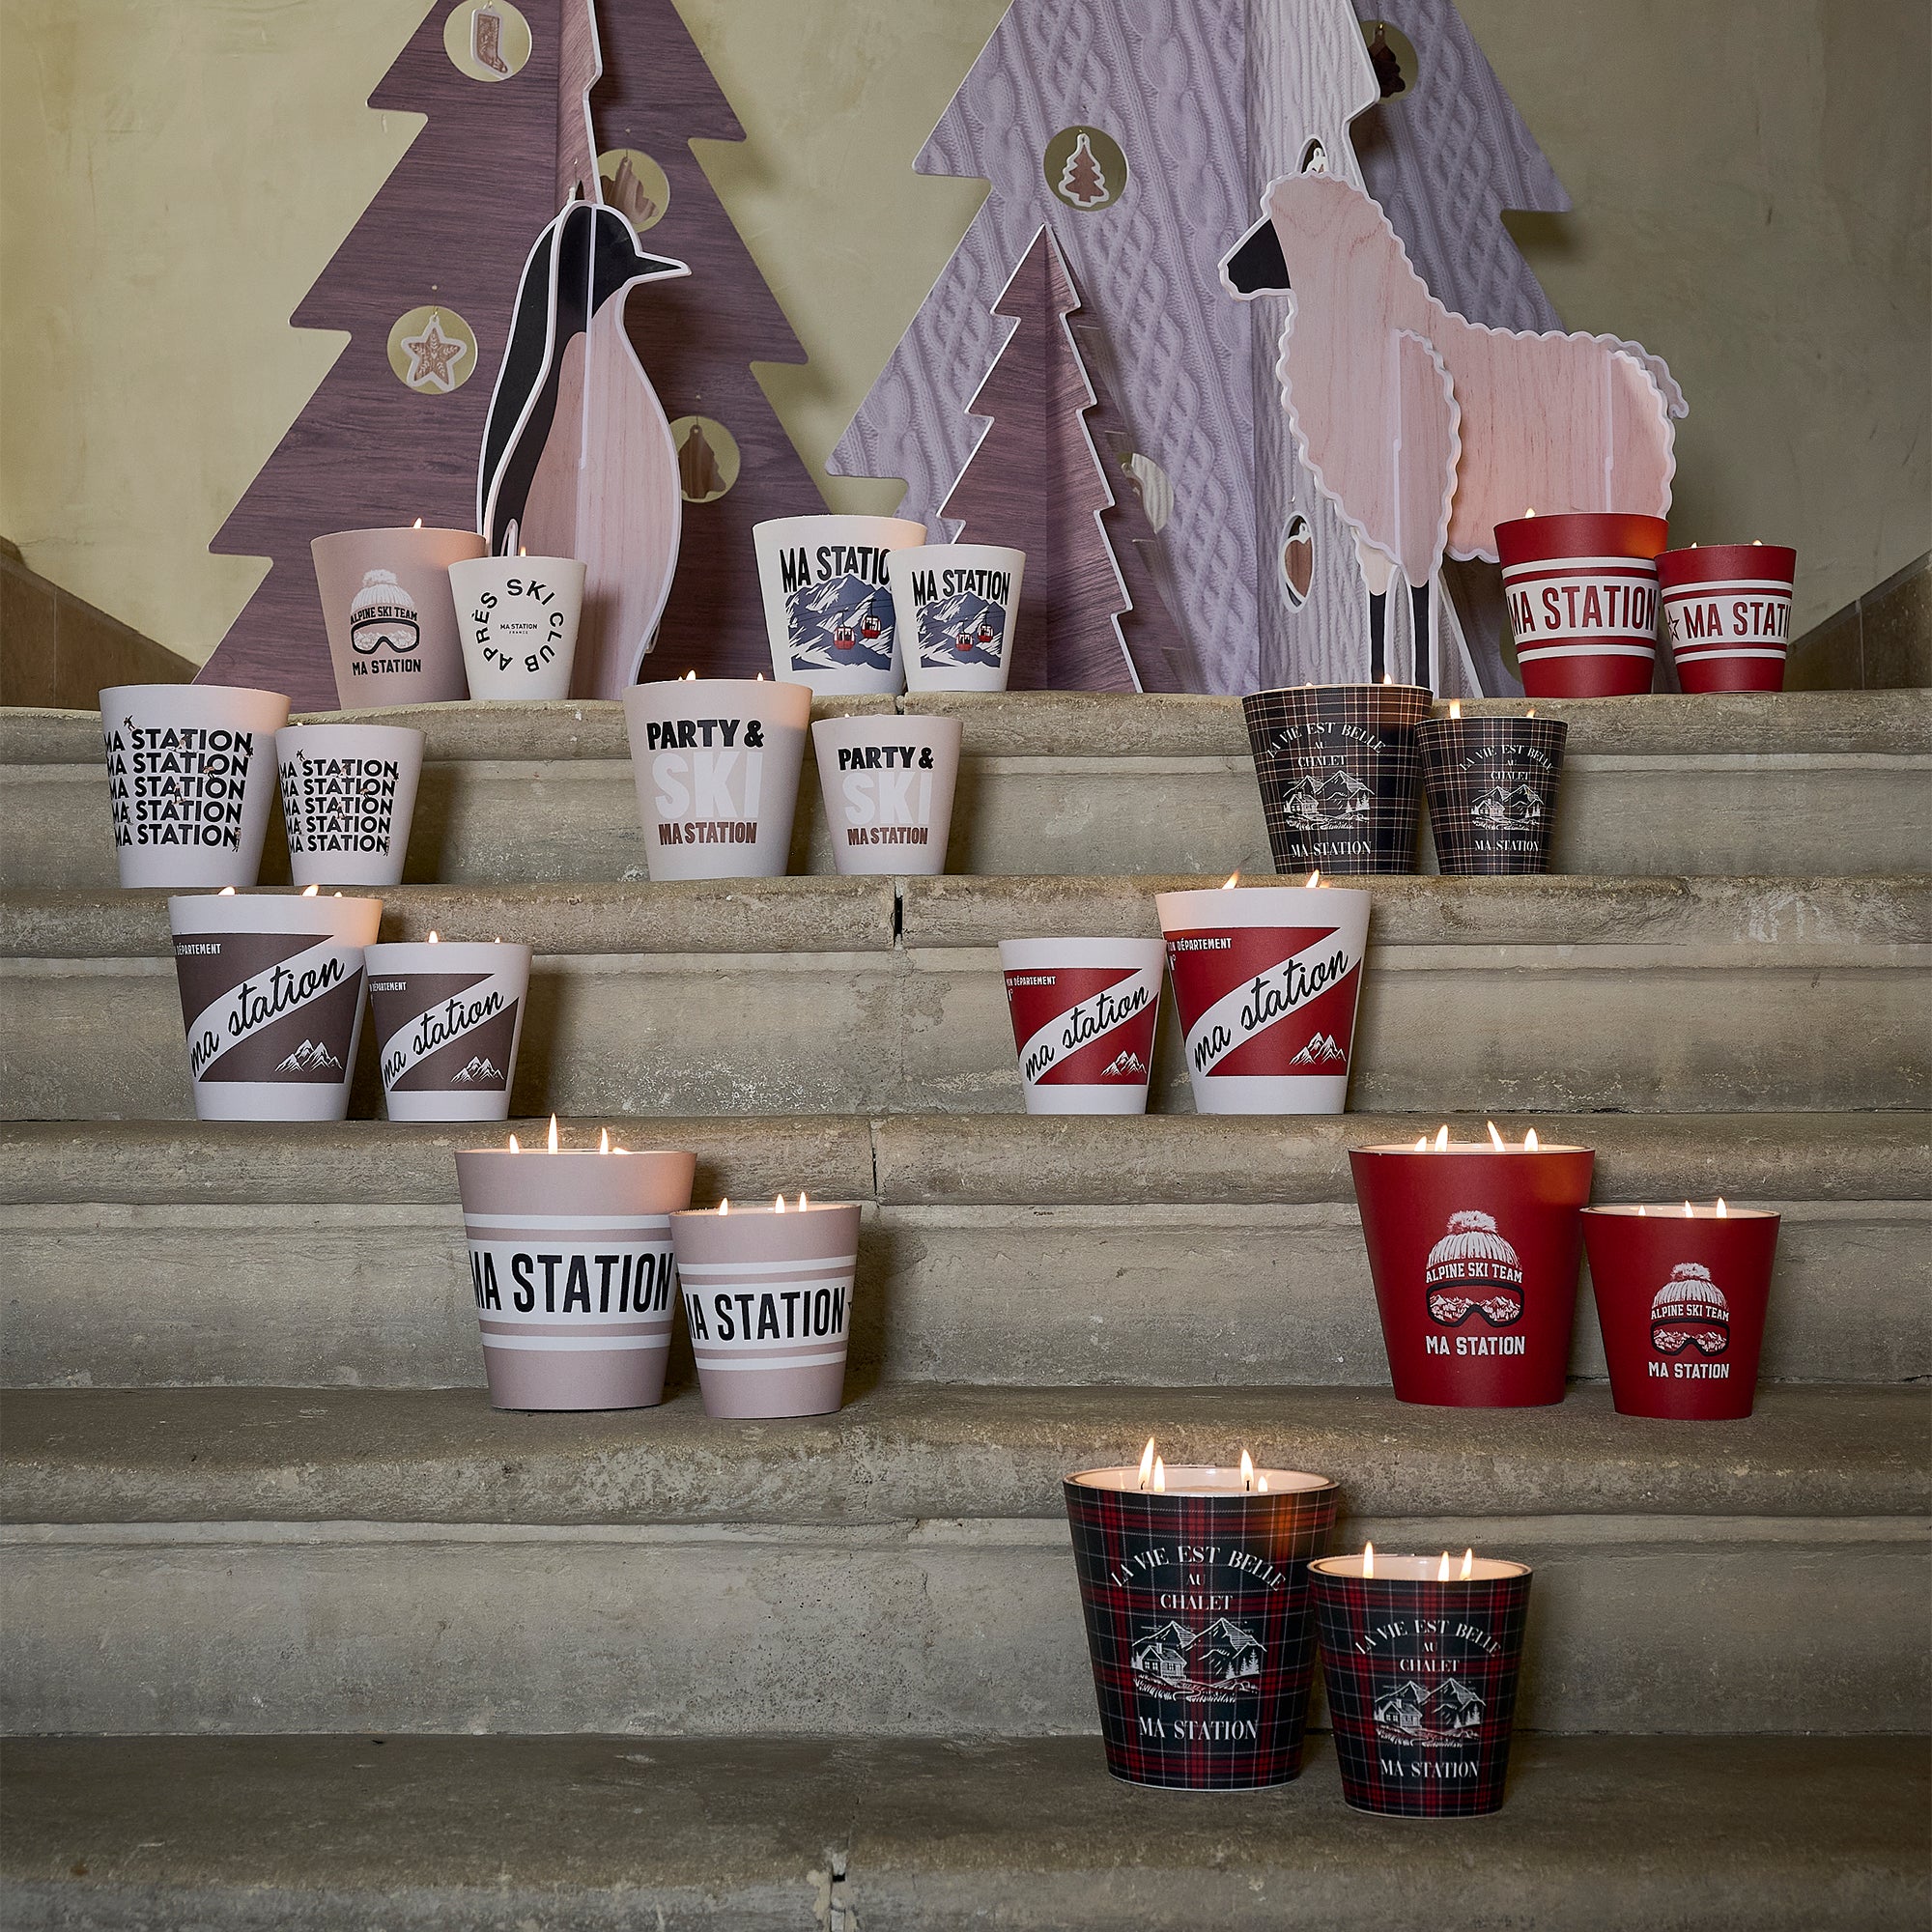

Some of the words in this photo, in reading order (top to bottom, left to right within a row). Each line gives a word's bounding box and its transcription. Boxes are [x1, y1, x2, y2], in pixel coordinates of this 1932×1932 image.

[780, 548, 811, 593] MA
[816, 546, 892, 585] STATIO
[507, 579, 555, 606] SKI
[912, 570, 938, 606] MA
[942, 569, 1010, 605] STATION
[351, 607, 376, 624] ALPINE
[378, 606, 392, 617] SKI
[394, 607, 417, 621] TEAM
[1507, 591, 1536, 636] MA
[1542, 585, 1657, 631] STATION
[1683, 603, 1722, 639] MA
[1732, 602, 1791, 639] STATI
[471, 592, 513, 671] APRÈS
[525, 612, 563, 672] CLUB
[352, 662, 368, 675] MA
[372, 659, 421, 673] STATION
[103, 730, 126, 753] MA
[131, 728, 252, 753] STATION
[646, 720, 740, 750] PARTY
[744, 720, 765, 748] &
[1267, 742, 1281, 758] LA
[1279, 726, 1302, 744] VIE
[1306, 722, 1336, 735] EST
[1341, 724, 1386, 754] BELLE
[106, 754, 128, 777] MA
[133, 753, 249, 777] STATION
[302, 758, 398, 778] STATION
[838, 747, 916, 771] PARTY
[919, 747, 933, 769] &
[1297, 755, 1348, 768] CHALET
[1459, 757, 1475, 771] LA
[1475, 746, 1497, 759] VIE
[1502, 744, 1524, 754] EST
[1527, 748, 1553, 773] BELLE
[303, 778, 395, 797] STATION
[652, 751, 763, 819] SKI
[1491, 771, 1530, 781] CHALET
[109, 778, 129, 800] MA
[134, 776, 245, 801] STATION
[842, 772, 932, 825] SKI
[112, 802, 129, 823] MA
[136, 800, 242, 824] STATION
[305, 797, 393, 815] STATION
[115, 825, 132, 846] MA
[137, 824, 240, 847] STATION
[306, 816, 390, 834] STATION
[658, 822, 683, 845] MA
[685, 821, 757, 844] STATION
[847, 828, 868, 845] MA
[870, 827, 928, 844] STATION
[308, 835, 387, 852] STATION
[1292, 843, 1309, 858] MA
[1314, 841, 1372, 856] STATION
[1475, 840, 1492, 851] MA
[1496, 839, 1539, 851] STATION
[1177, 938, 1232, 951] DÉPARTEMENT
[1014, 976, 1056, 986] DÉPARTEMENT
[190, 1031, 219, 1077] ma
[228, 958, 345, 1037] station
[1194, 1025, 1231, 1072] ma
[1240, 950, 1349, 1030] station
[382, 1051, 407, 1088] ma
[412, 991, 504, 1055] station
[1026, 1045, 1055, 1081] ma
[1062, 986, 1149, 1049] station
[511, 1252, 674, 1313] STATION
[1426, 1264, 1465, 1284] ALPINE
[1468, 1262, 1489, 1277] SKI
[1492, 1264, 1522, 1284] TEAM
[714, 1287, 846, 1341] STATION
[1651, 1304, 1684, 1320] ALPINE
[1687, 1304, 1702, 1316] SKI
[1706, 1305, 1729, 1321] TEAM
[1425, 1335, 1450, 1354] MA
[1456, 1336, 1525, 1355] STATION
[1648, 1361, 1668, 1378] MA
[1674, 1363, 1729, 1378] STATION
[1111, 1563, 1134, 1587] LA
[1134, 1548, 1169, 1571] VIE
[1177, 1546, 1221, 1563] EST
[1228, 1550, 1287, 1591] BELLE
[1186, 1574, 1207, 1586] AU
[1160, 1594, 1233, 1610] CHALET
[1355, 1634, 1377, 1655] LA
[1377, 1621, 1408, 1640] VIE
[1414, 1619, 1450, 1634] EST
[1456, 1623, 1501, 1658] BELLE
[1422, 1642, 1437, 1652] AU
[1400, 1659, 1460, 1672] CHALET
[1139, 1717, 1166, 1739] MA
[1174, 1719, 1258, 1741] STATION
[1380, 1759, 1404, 1777] MA
[1411, 1761, 1480, 1778] STATION
